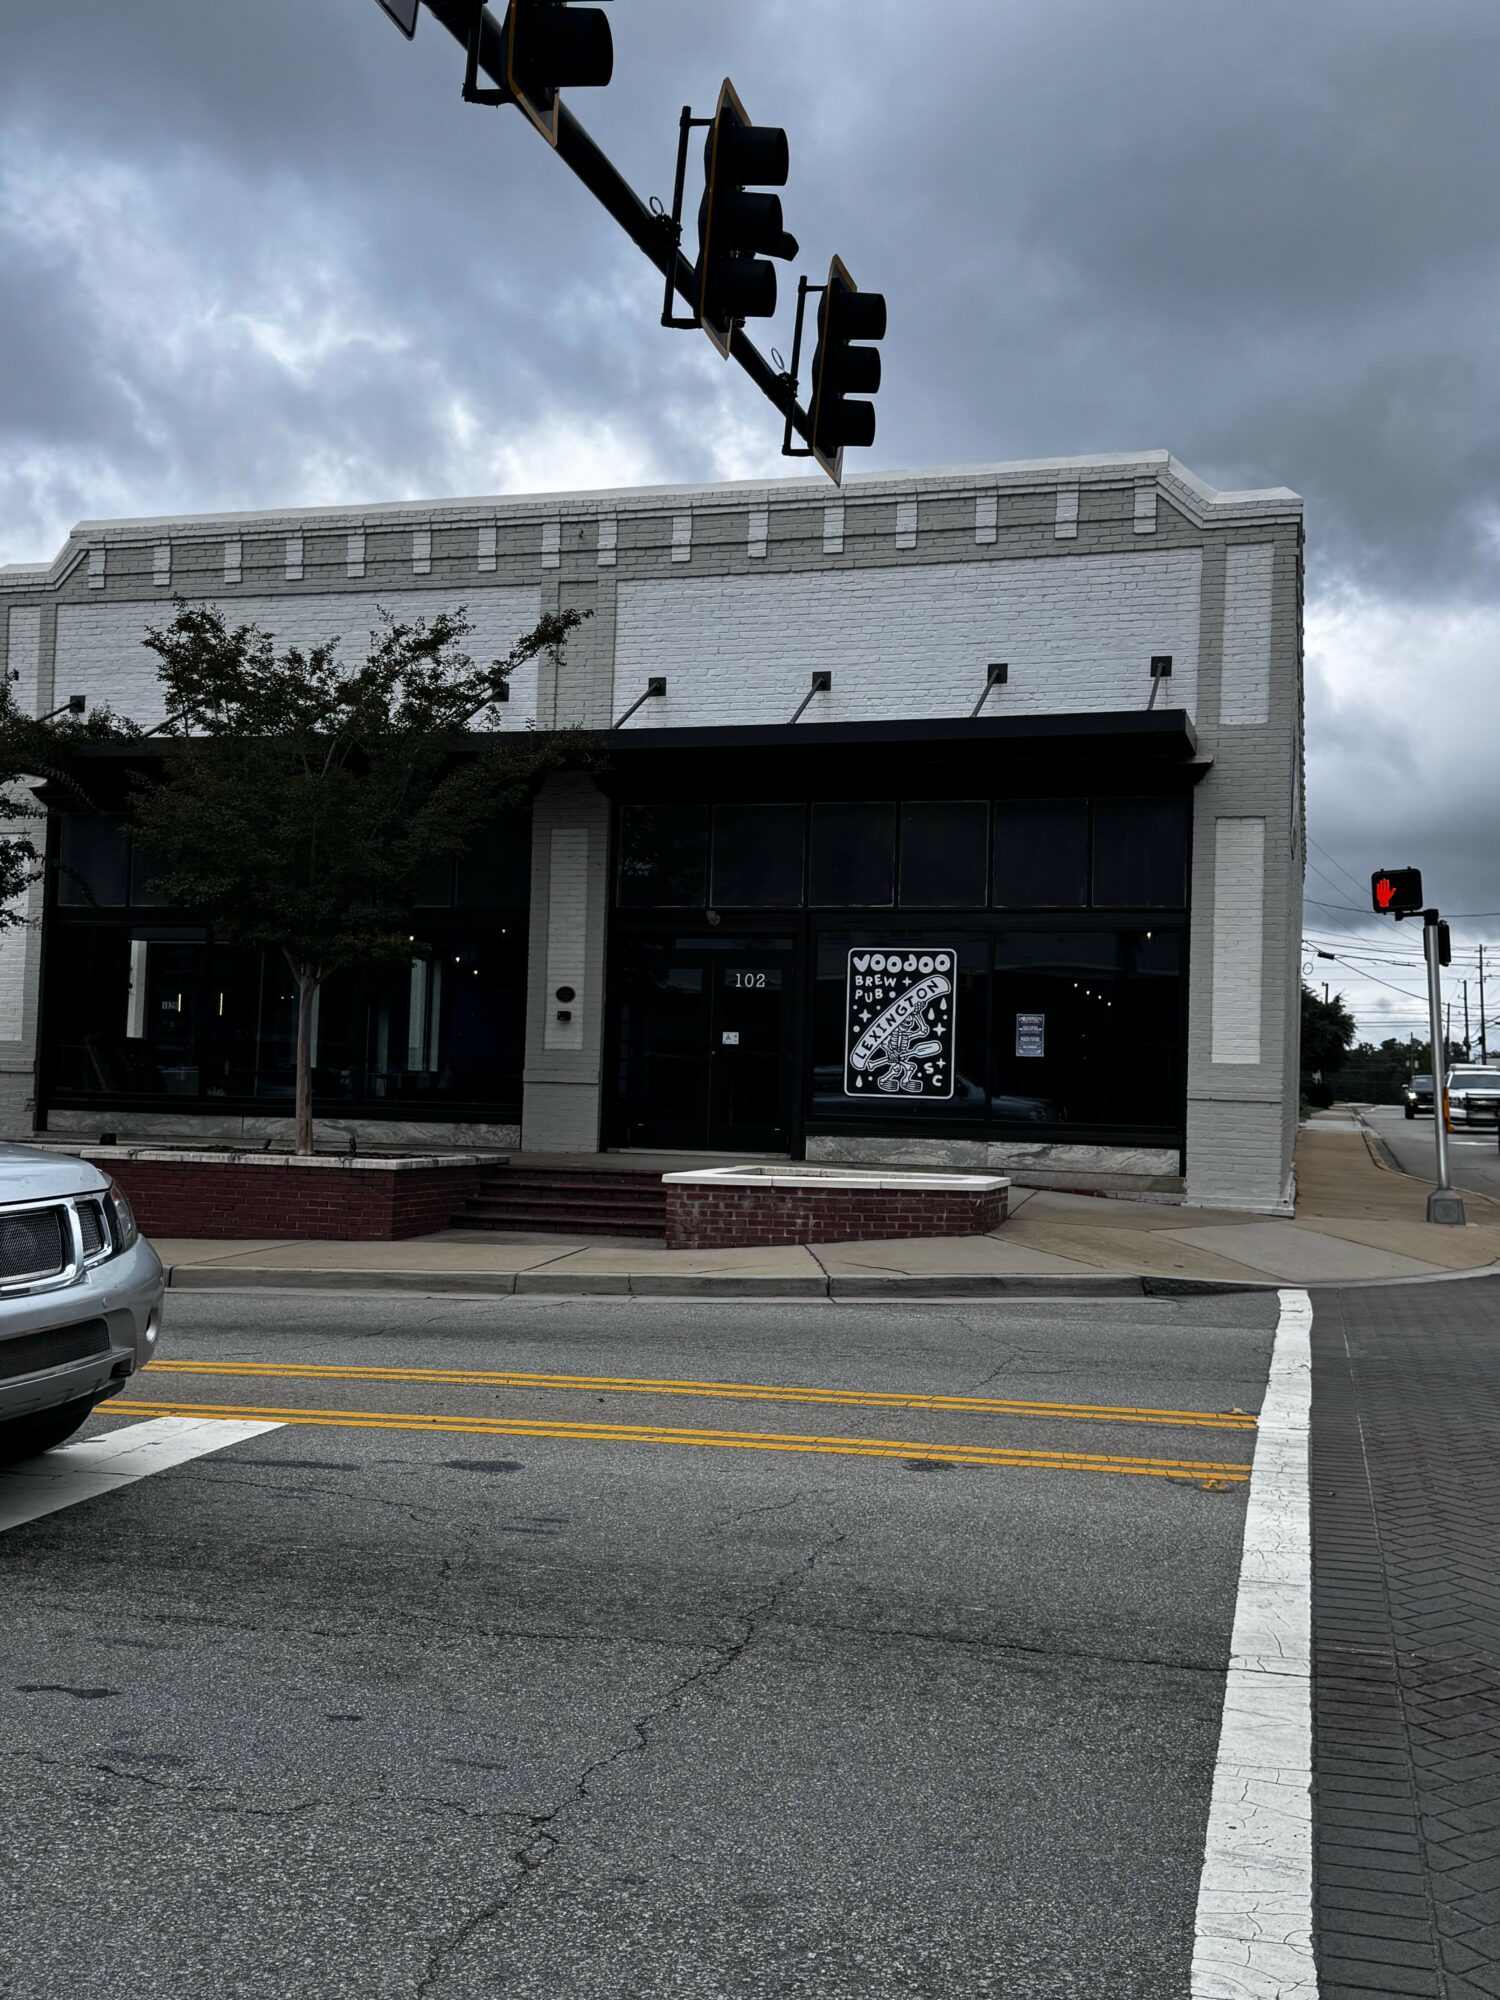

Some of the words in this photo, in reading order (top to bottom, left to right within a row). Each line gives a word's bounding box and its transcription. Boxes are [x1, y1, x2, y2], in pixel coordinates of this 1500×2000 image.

[735, 973, 766, 988] 102
[855, 974, 897, 987] BREW
[854, 988, 884, 1003] PUB
[854, 979, 940, 1060] LEXINGTON
